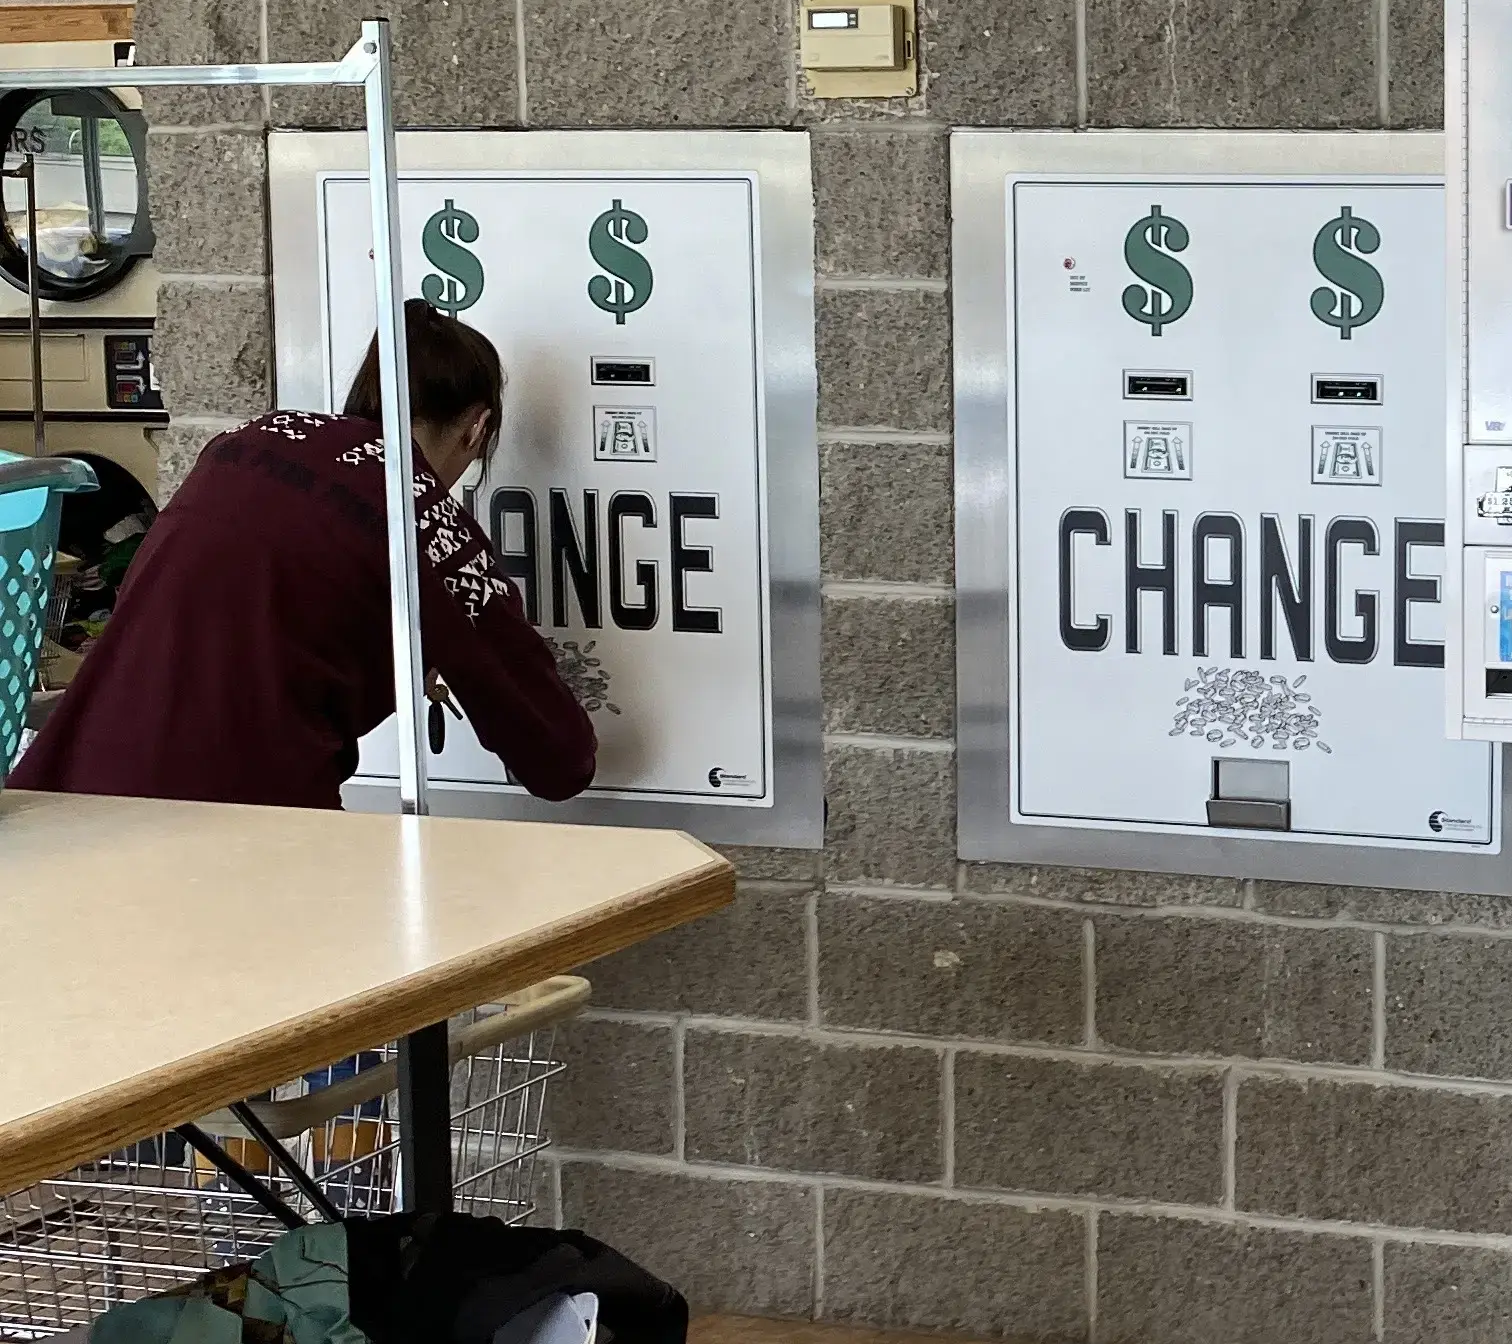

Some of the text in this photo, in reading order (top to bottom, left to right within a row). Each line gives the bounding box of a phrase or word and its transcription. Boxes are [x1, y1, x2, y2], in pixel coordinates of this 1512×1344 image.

[421, 199, 653, 325] $ $
[1122, 204, 1384, 340] $ $
[463, 485, 722, 633] ANGE
[1059, 506, 1445, 669] CHANGE
